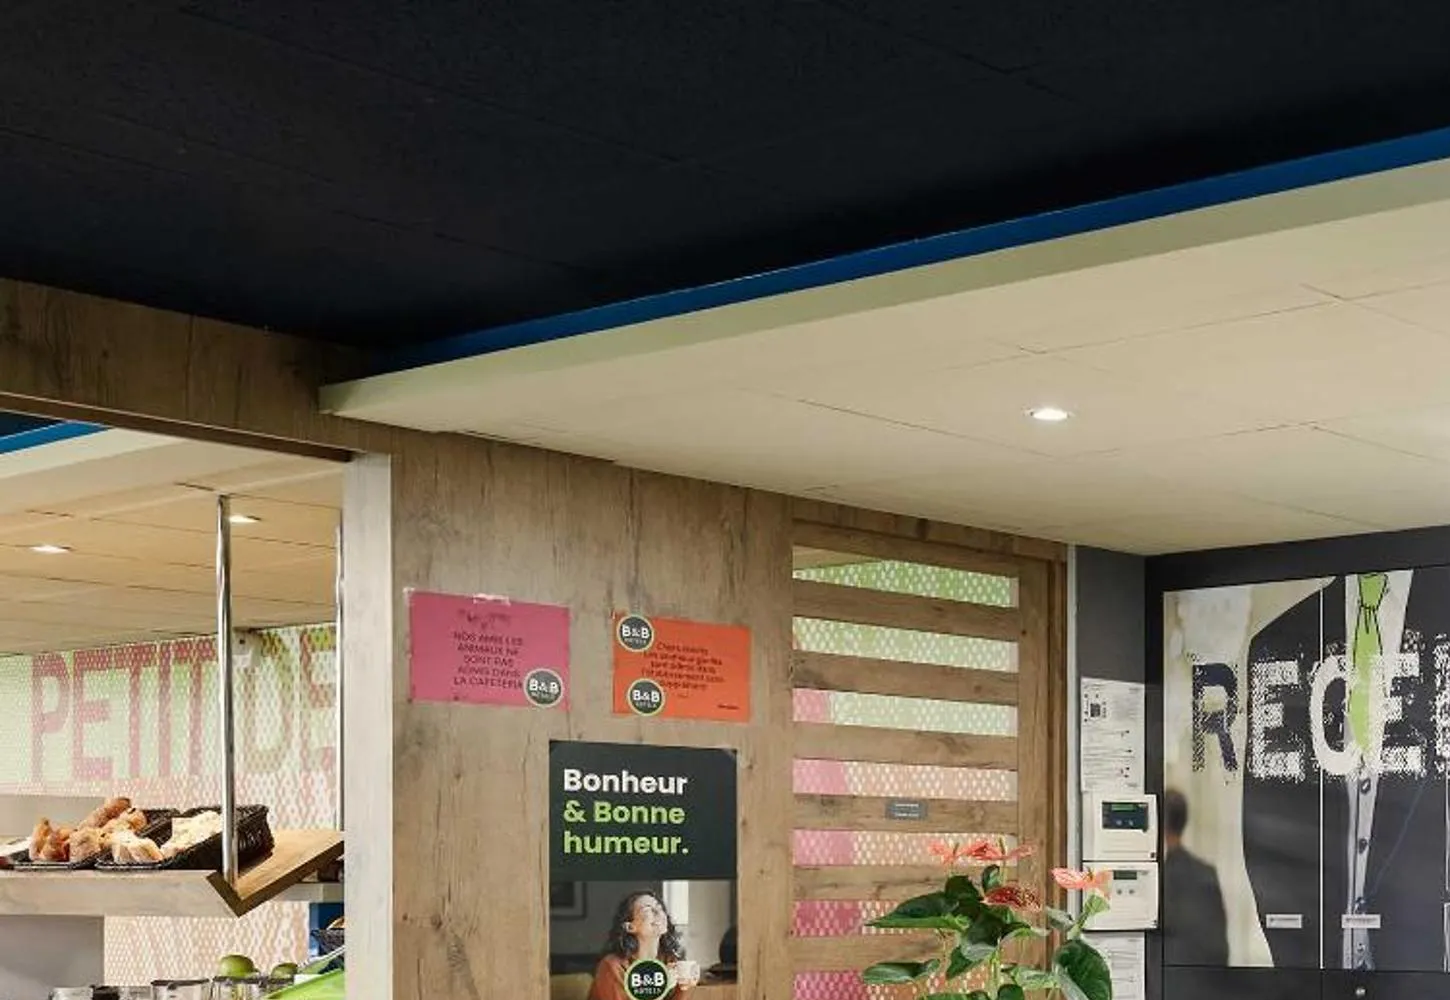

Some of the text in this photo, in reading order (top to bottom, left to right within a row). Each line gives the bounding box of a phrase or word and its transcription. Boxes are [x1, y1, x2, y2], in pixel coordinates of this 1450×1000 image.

[622, 625, 650, 639] B&B
[529, 678, 560, 694] B&B
[633, 690, 660, 702] B&B
[563, 769, 688, 795] Bonheur
[563, 800, 685, 825] & Bonne
[563, 831, 689, 855] humeur.
[631, 971, 665, 987] B&B
